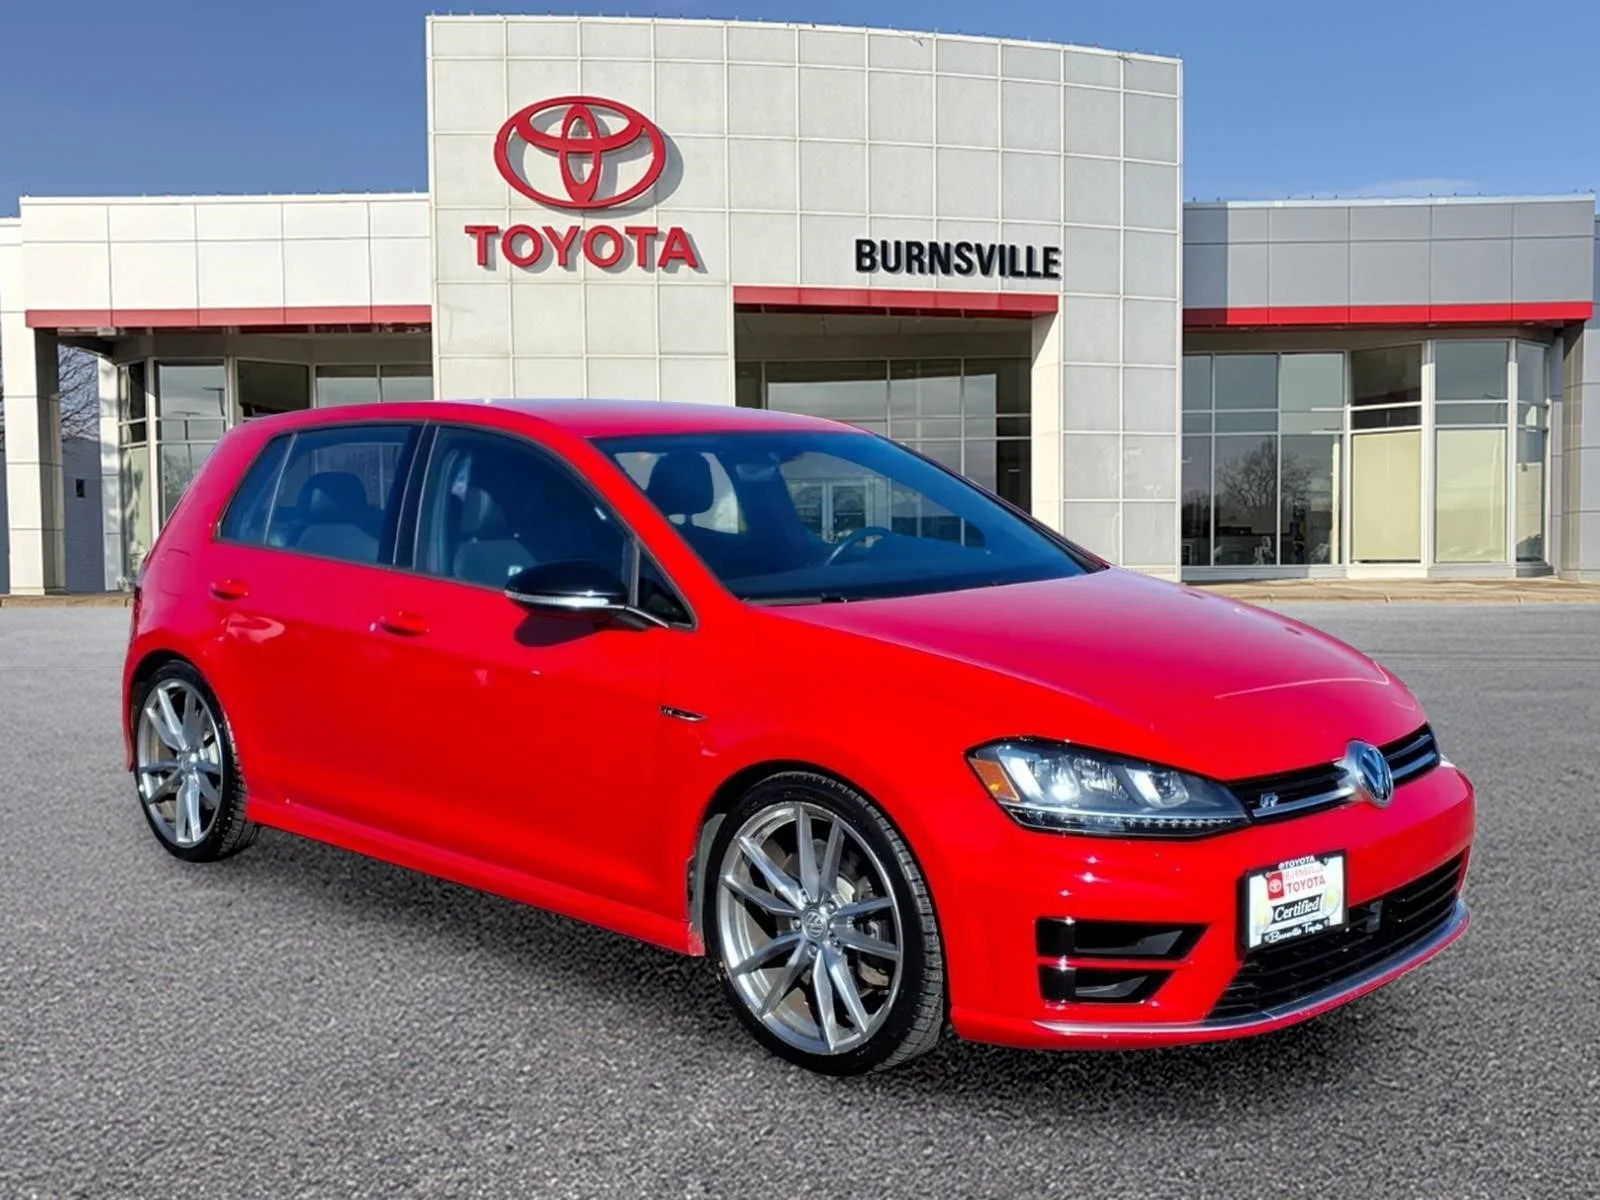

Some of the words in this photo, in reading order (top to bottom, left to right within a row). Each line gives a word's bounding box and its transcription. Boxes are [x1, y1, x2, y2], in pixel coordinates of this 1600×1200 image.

[464, 224, 699, 269] TOYOTA
[855, 238, 1061, 279] BURNSVILLE
[1285, 856, 1316, 869] TOYOTA
[1286, 875, 1326, 894] TOYOTA
[1275, 897, 1319, 921] Certified
